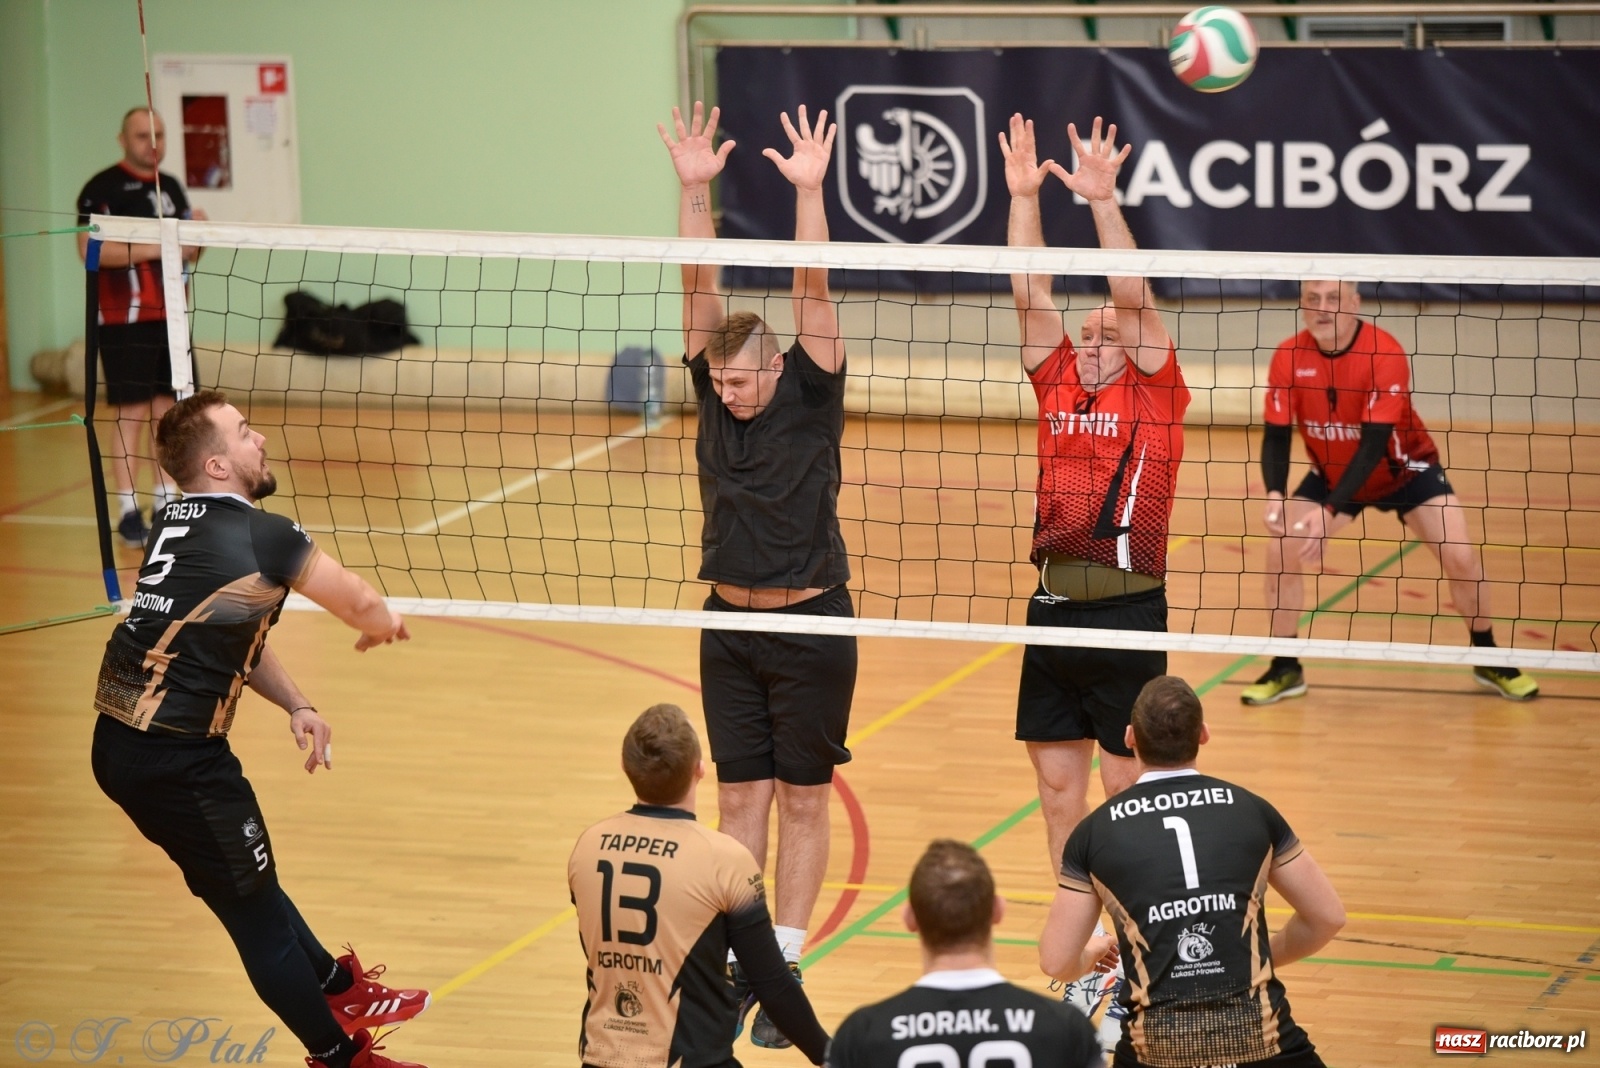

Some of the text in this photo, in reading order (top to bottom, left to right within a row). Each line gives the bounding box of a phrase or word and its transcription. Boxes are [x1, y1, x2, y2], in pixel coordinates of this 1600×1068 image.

[139, 526, 190, 585] 5
[133, 592, 174, 613] ROTIM
[1109, 788, 1234, 821] KOŁODZIEJ
[253, 843, 268, 871] 5
[599, 833, 679, 859] TAPPER
[1163, 816, 1200, 889] 1
[596, 859, 662, 946] 13
[1148, 893, 1236, 923] AGROTIM
[891, 1008, 1035, 1040] SIORAK. W
